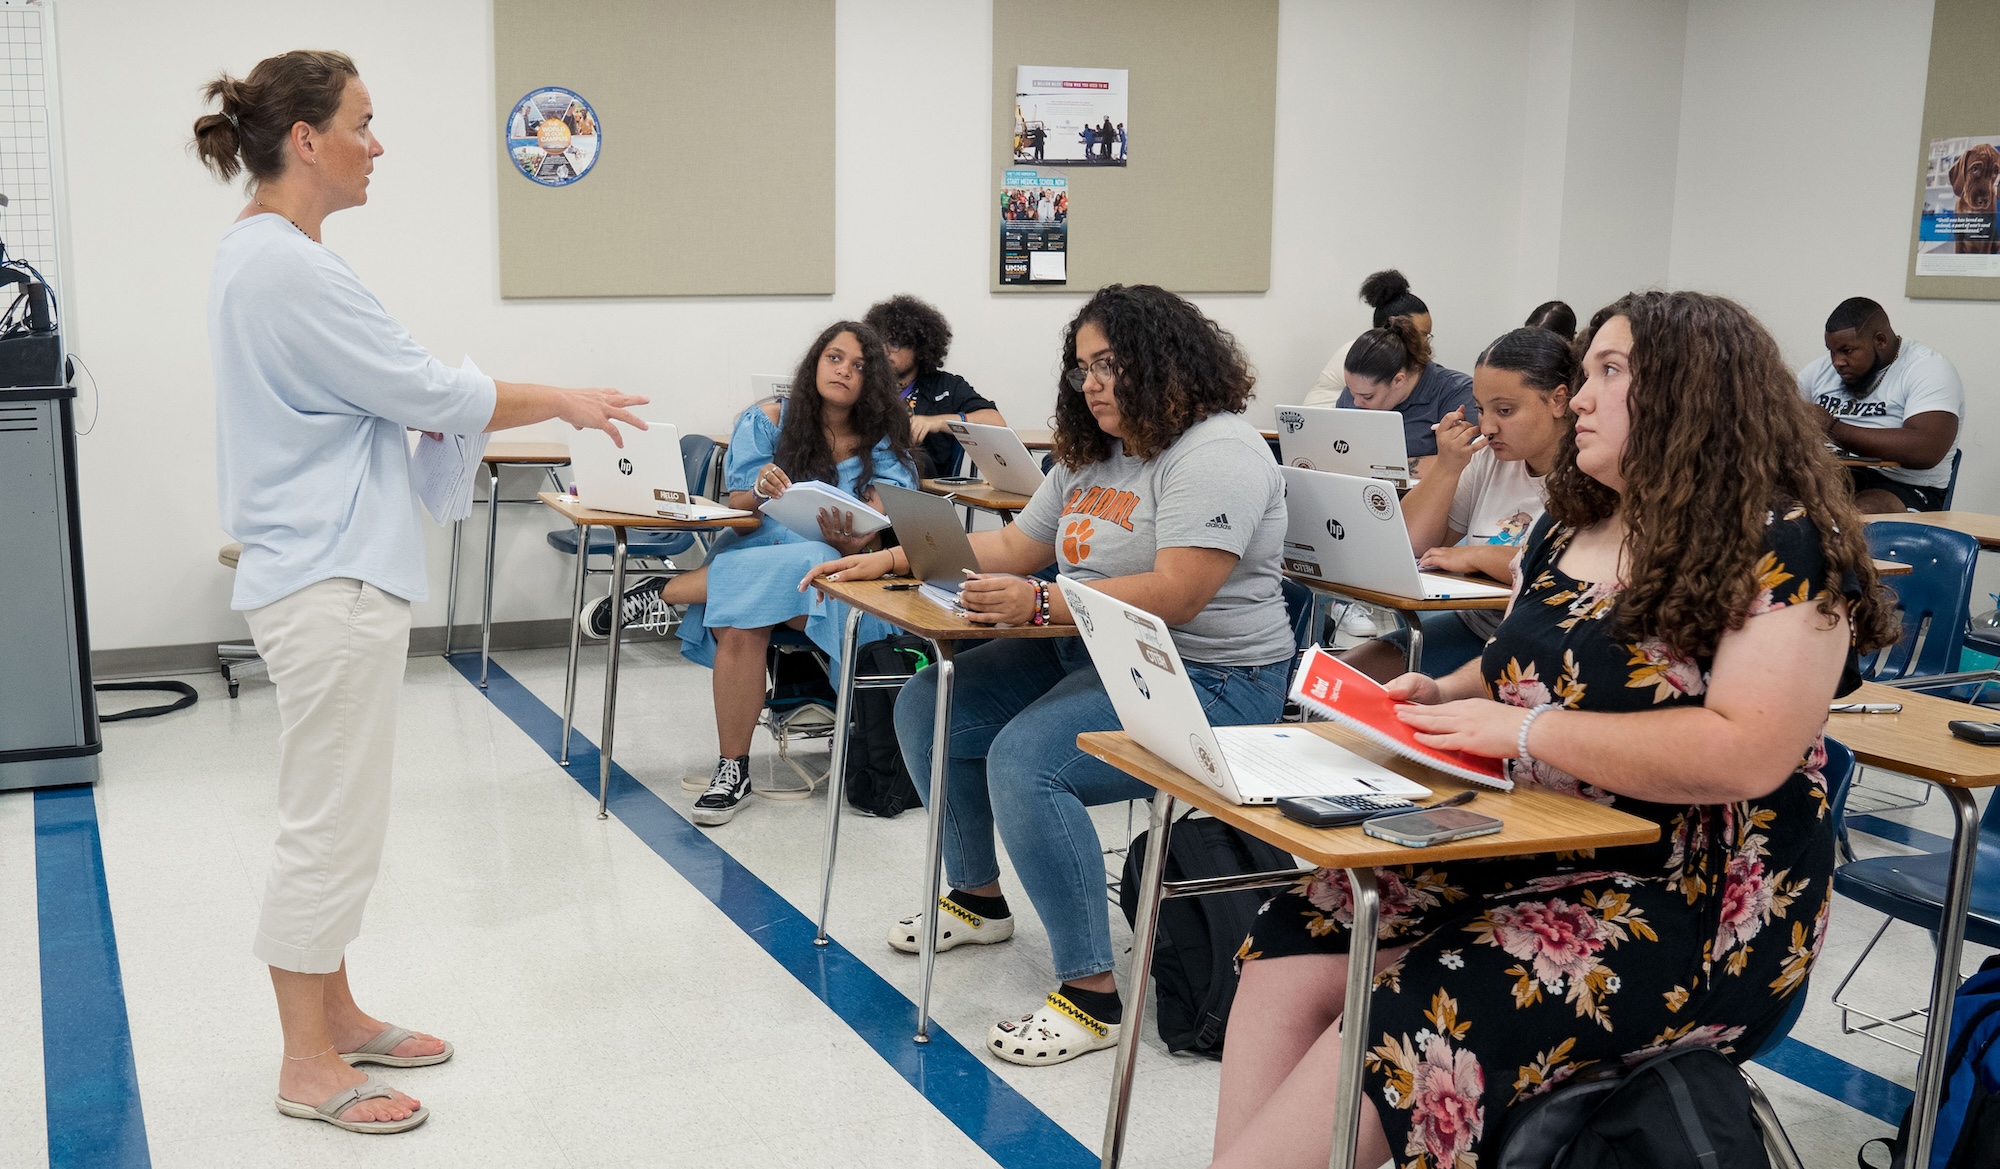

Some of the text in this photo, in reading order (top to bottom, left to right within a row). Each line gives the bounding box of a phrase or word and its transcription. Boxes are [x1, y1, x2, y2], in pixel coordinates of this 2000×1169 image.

[1820, 394, 1887, 416] BRAVES
[1334, 440, 1349, 454] hp
[618, 458, 632, 475] hp
[660, 491, 679, 500] HELLO
[1326, 518, 1345, 540] hp
[1293, 562, 1314, 574] HELLO
